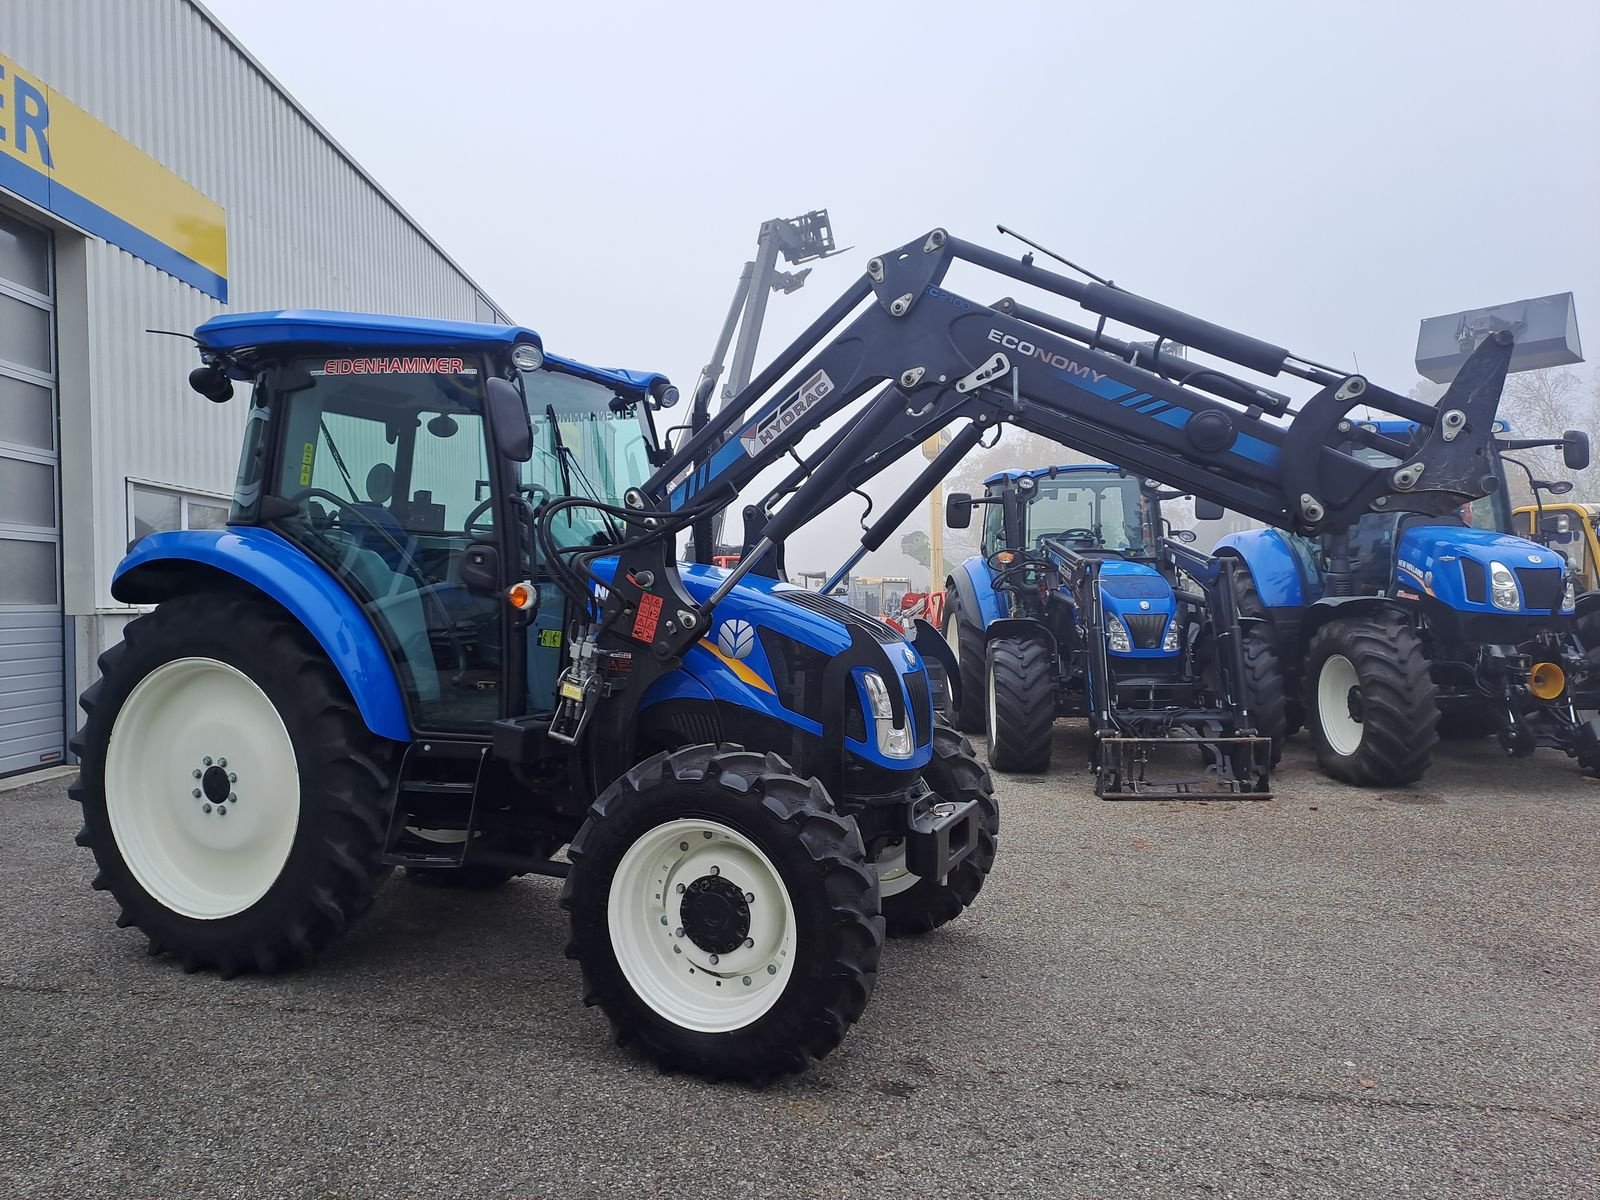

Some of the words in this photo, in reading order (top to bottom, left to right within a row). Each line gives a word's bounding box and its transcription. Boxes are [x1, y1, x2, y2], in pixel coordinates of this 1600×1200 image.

[0, 64, 55, 170] R
[987, 328, 1107, 383] ECONOMY
[759, 382, 829, 446] HYDRAC
